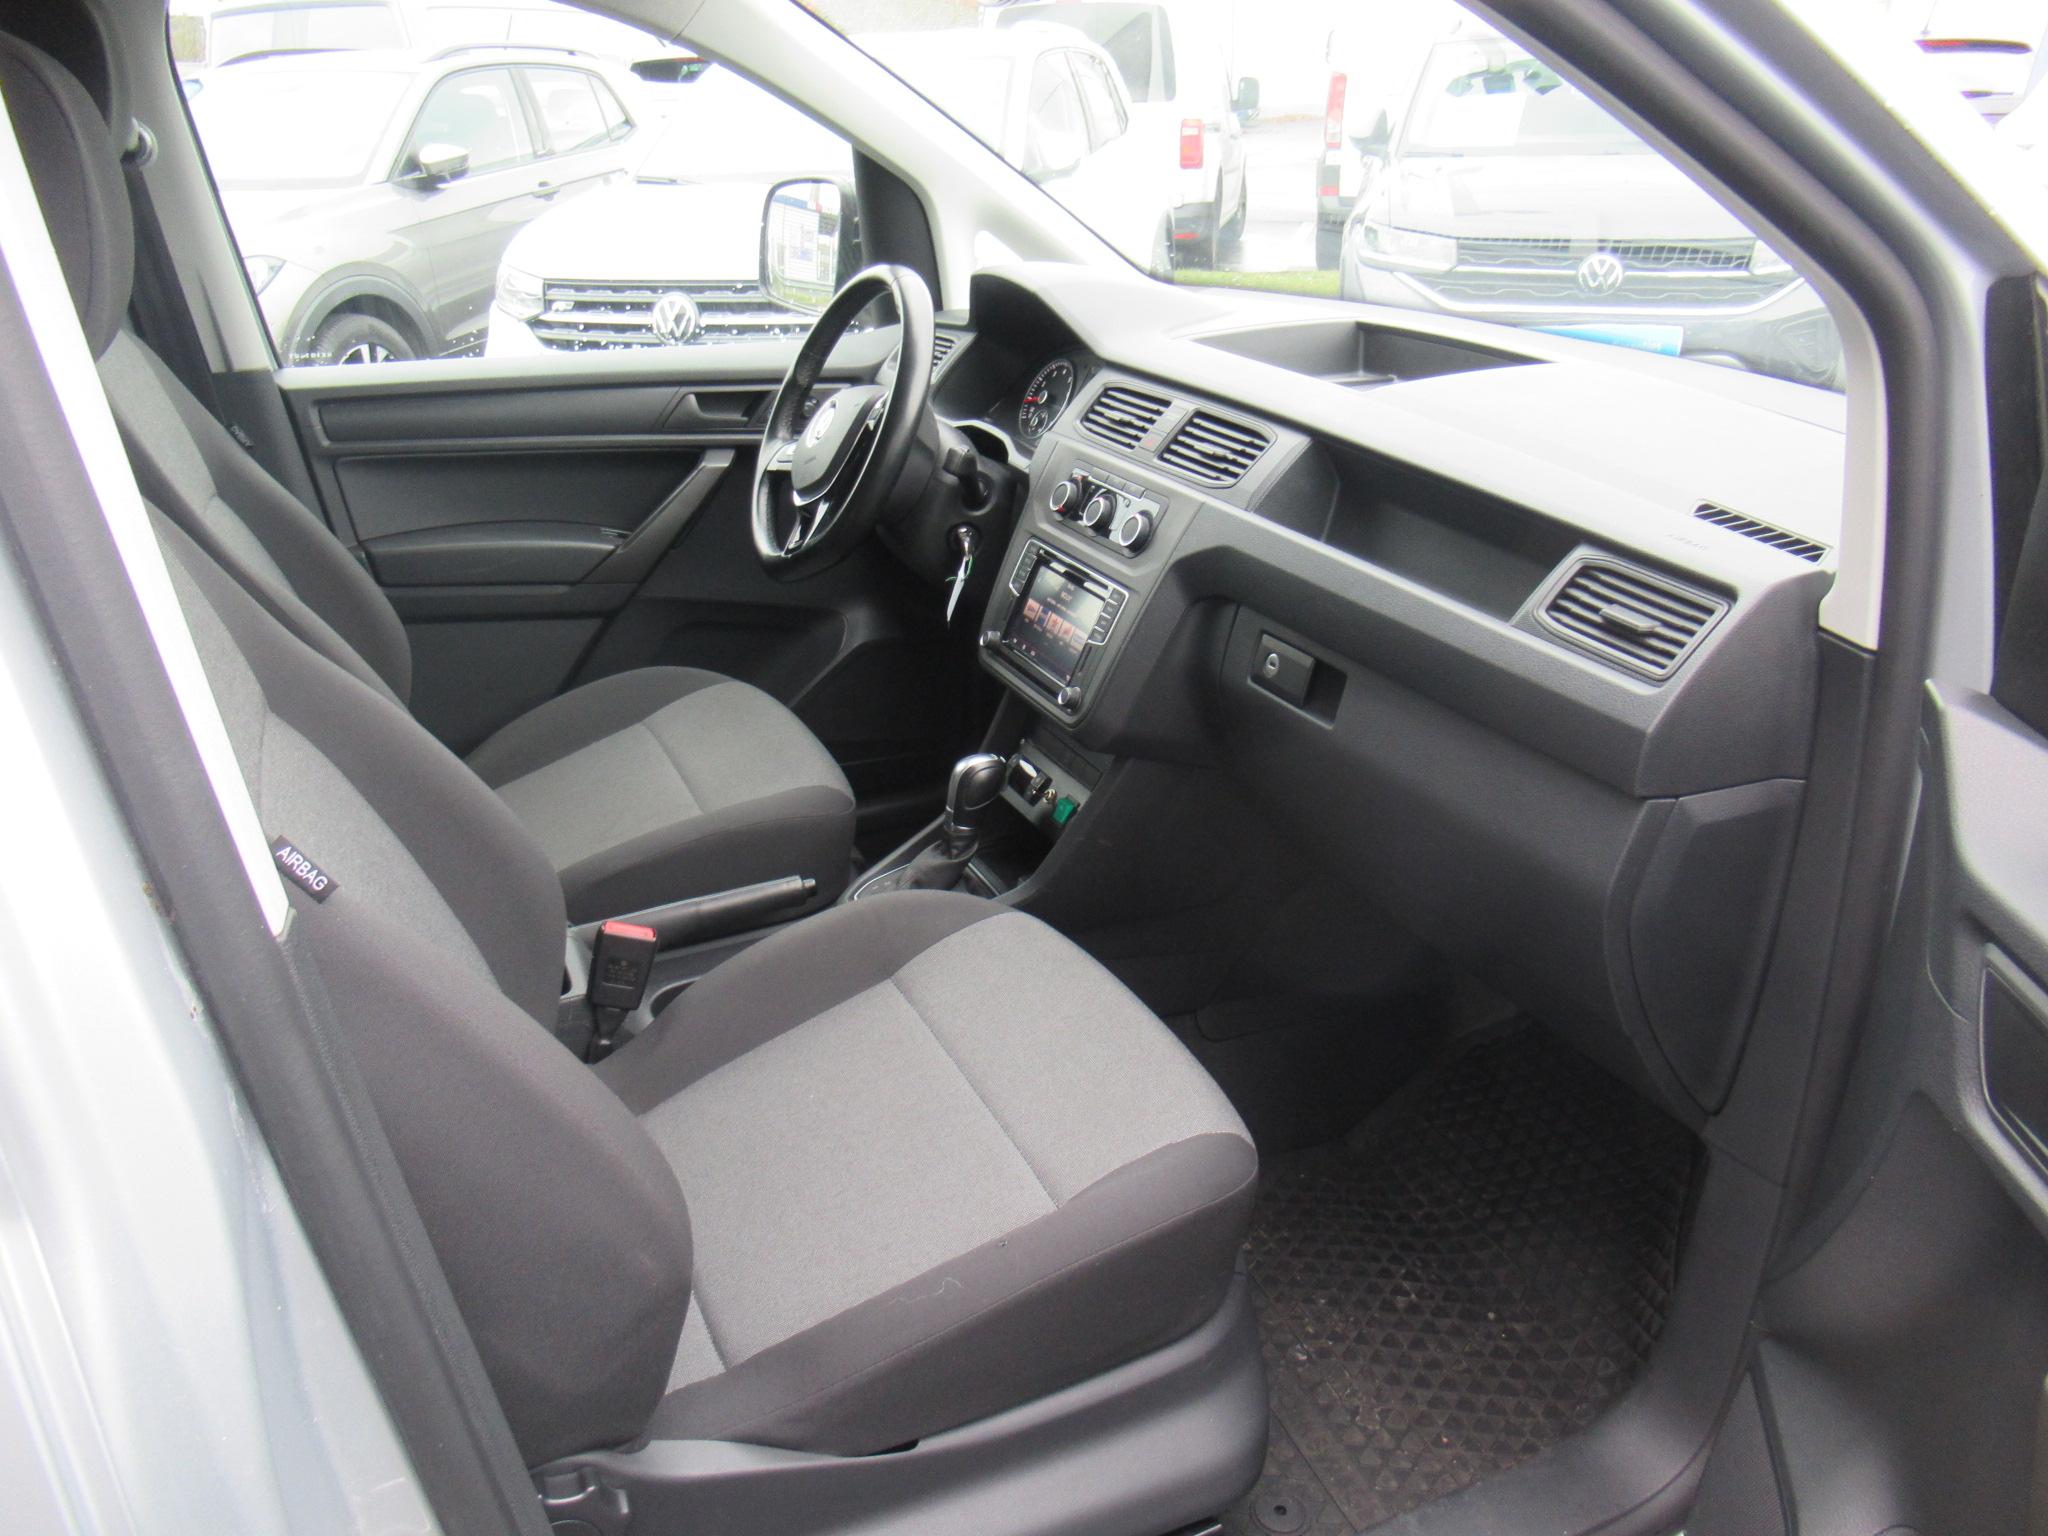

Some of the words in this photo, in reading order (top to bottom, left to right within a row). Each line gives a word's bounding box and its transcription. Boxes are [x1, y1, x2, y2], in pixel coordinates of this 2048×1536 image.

[1579, 254, 1623, 295] VW
[653, 292, 697, 346] VW
[275, 846, 328, 891] AIRBAG
